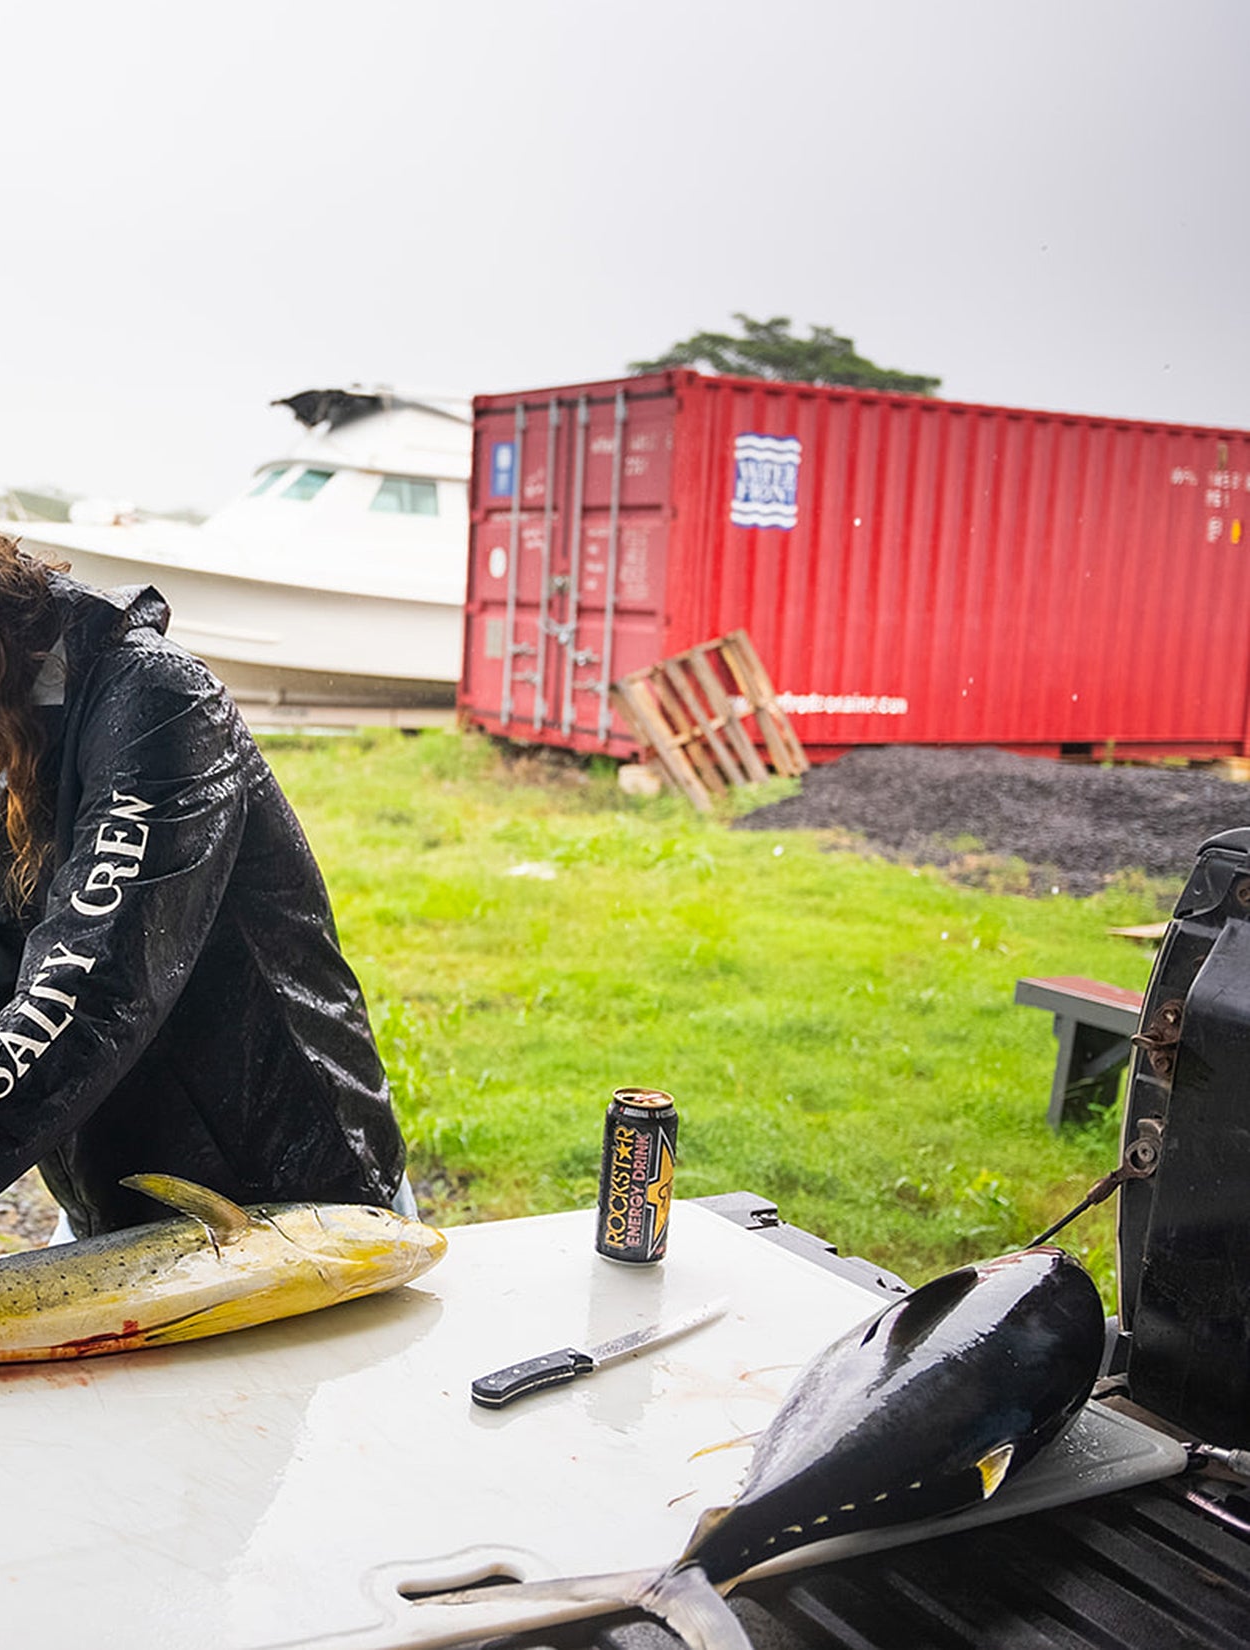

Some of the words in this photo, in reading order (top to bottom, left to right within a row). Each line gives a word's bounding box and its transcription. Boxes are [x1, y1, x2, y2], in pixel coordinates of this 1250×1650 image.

[605, 1126, 636, 1248] ROCKSTAR
[632, 1132, 650, 1181] DRINK
[626, 1183, 645, 1247] ENERGY
